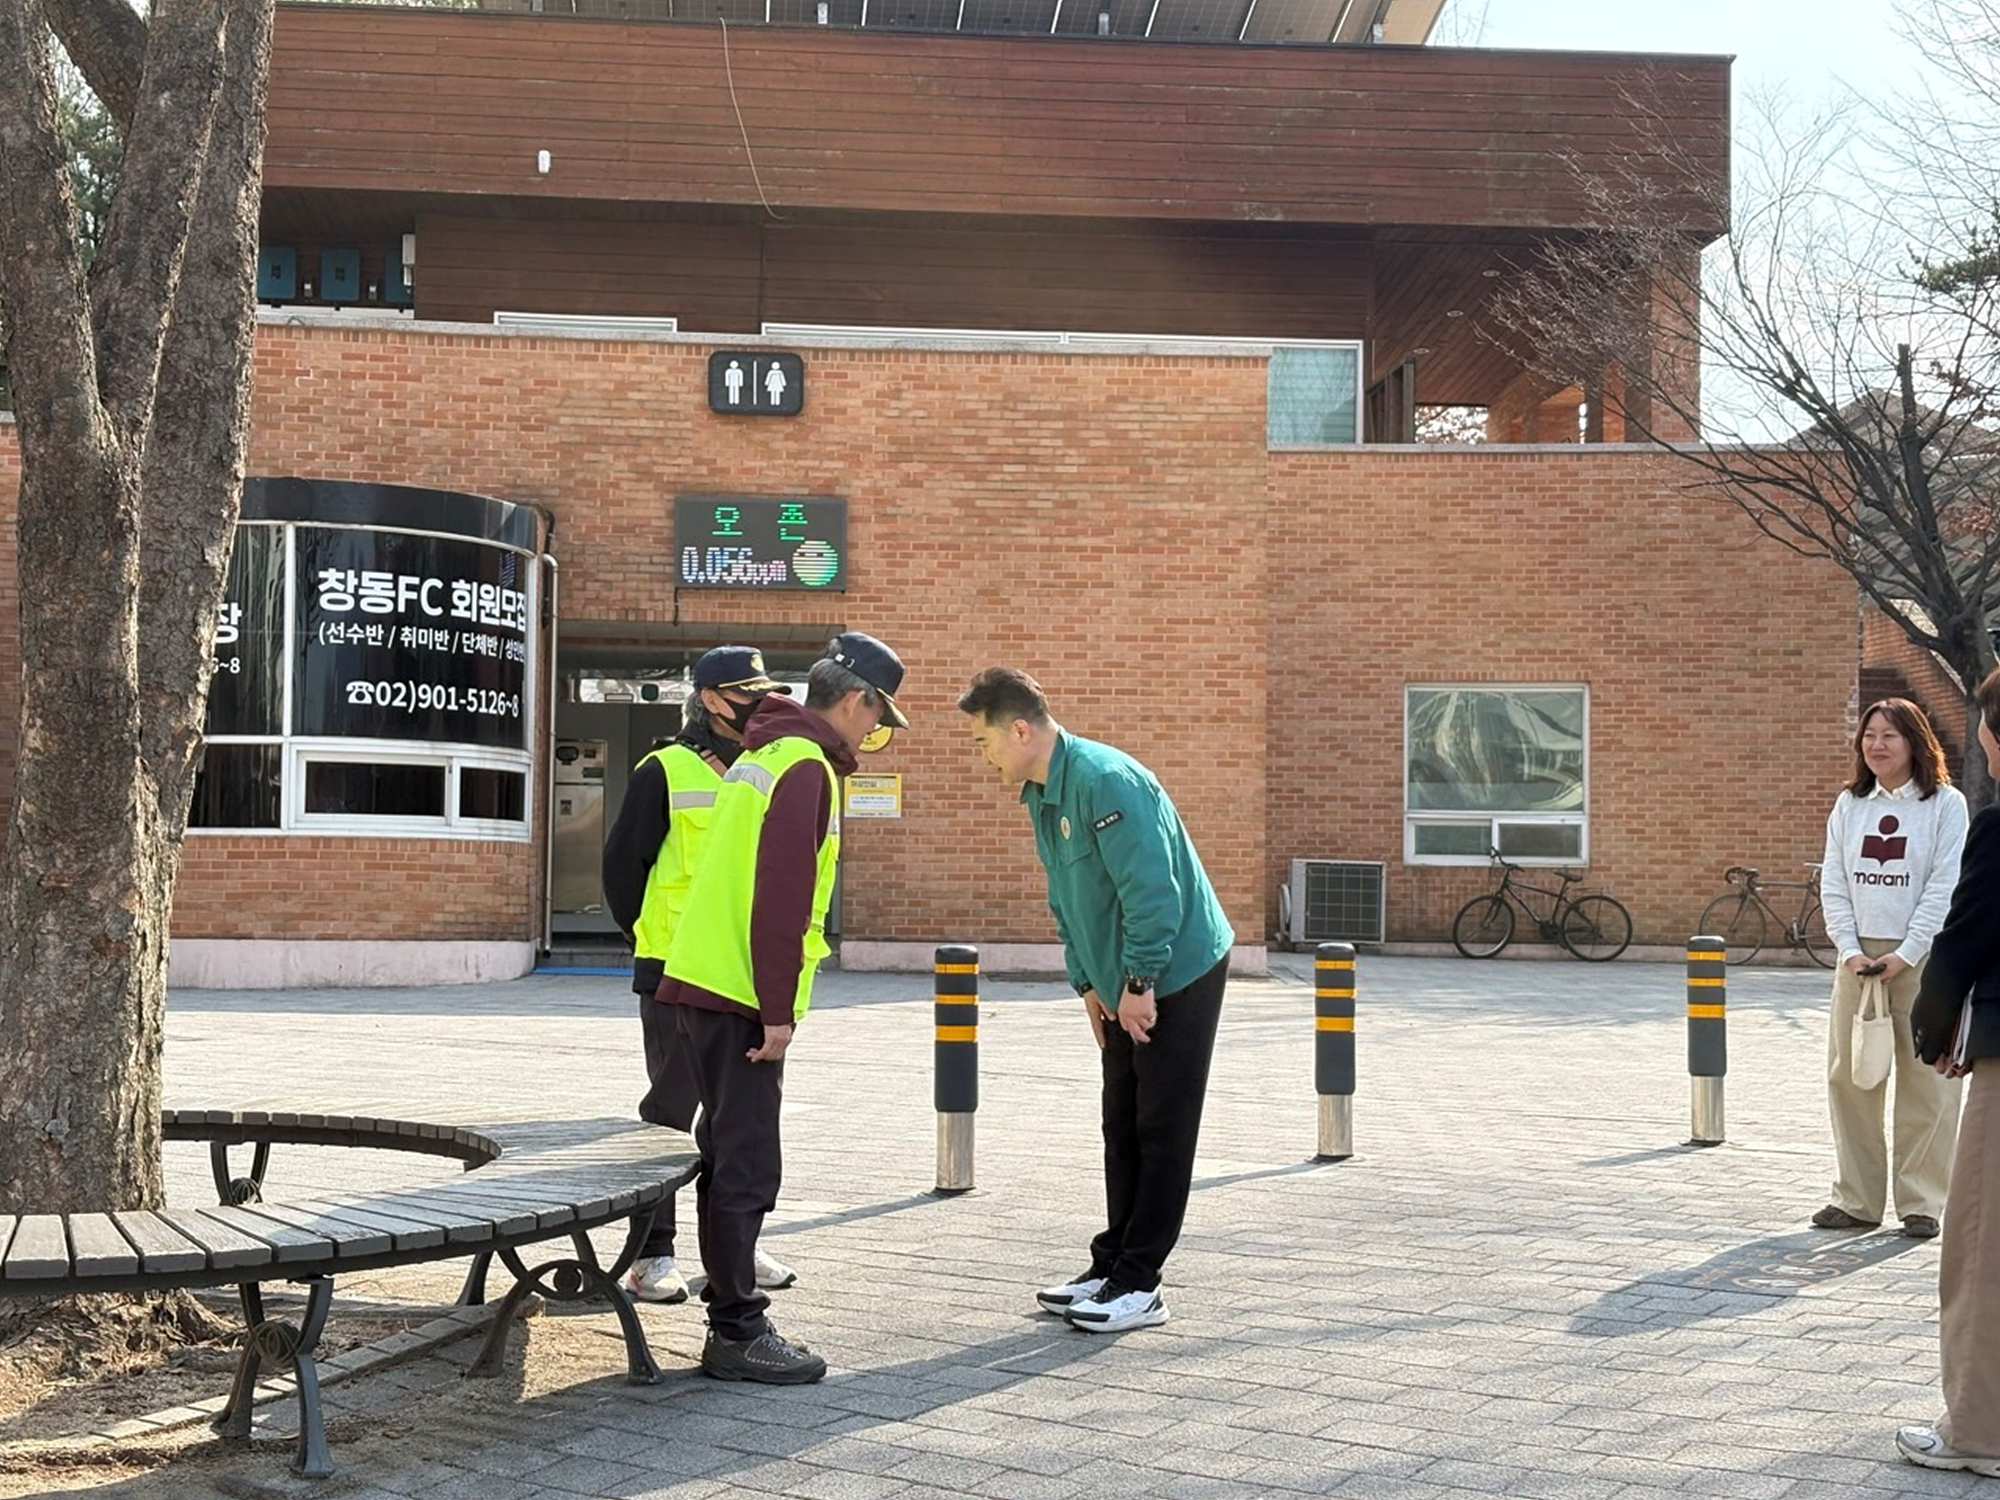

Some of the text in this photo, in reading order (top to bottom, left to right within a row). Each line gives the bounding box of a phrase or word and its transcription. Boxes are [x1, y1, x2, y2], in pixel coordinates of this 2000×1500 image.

[317, 568, 527, 633] 창동FC 회원모집
[318, 620, 385, 646] (선수반
[387, 625, 397, 649] /
[399, 626, 451, 651] 취미반
[451, 630, 460, 654] /
[461, 632, 499, 657] 단체반
[375, 680, 520, 718] 02)901-5126~8
[1853, 871, 1911, 888] marant
